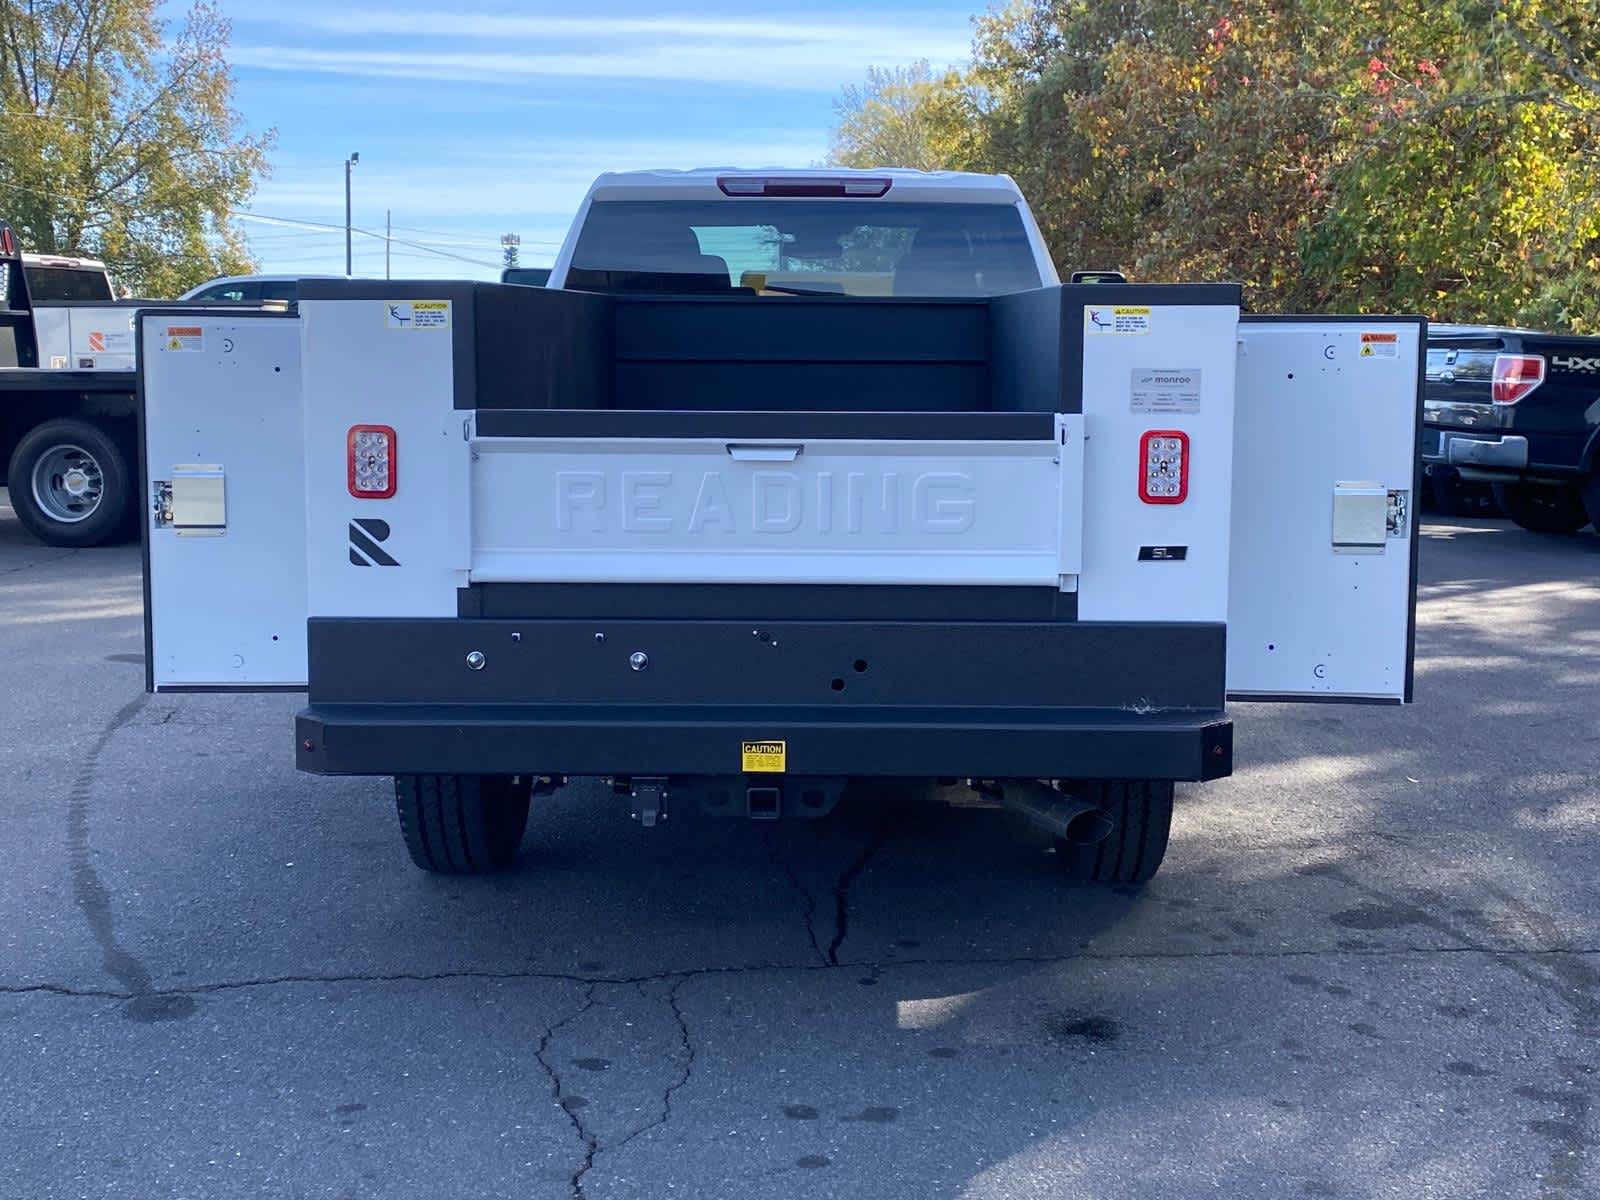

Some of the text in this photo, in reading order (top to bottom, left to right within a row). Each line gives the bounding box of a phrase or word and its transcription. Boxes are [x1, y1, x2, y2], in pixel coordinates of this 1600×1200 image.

[1552, 355, 1600, 370] 4X
[1154, 376, 1191, 384] monroe
[554, 470, 977, 536] READING
[1152, 547, 1173, 559] SL
[745, 744, 781, 753] CAUTION
